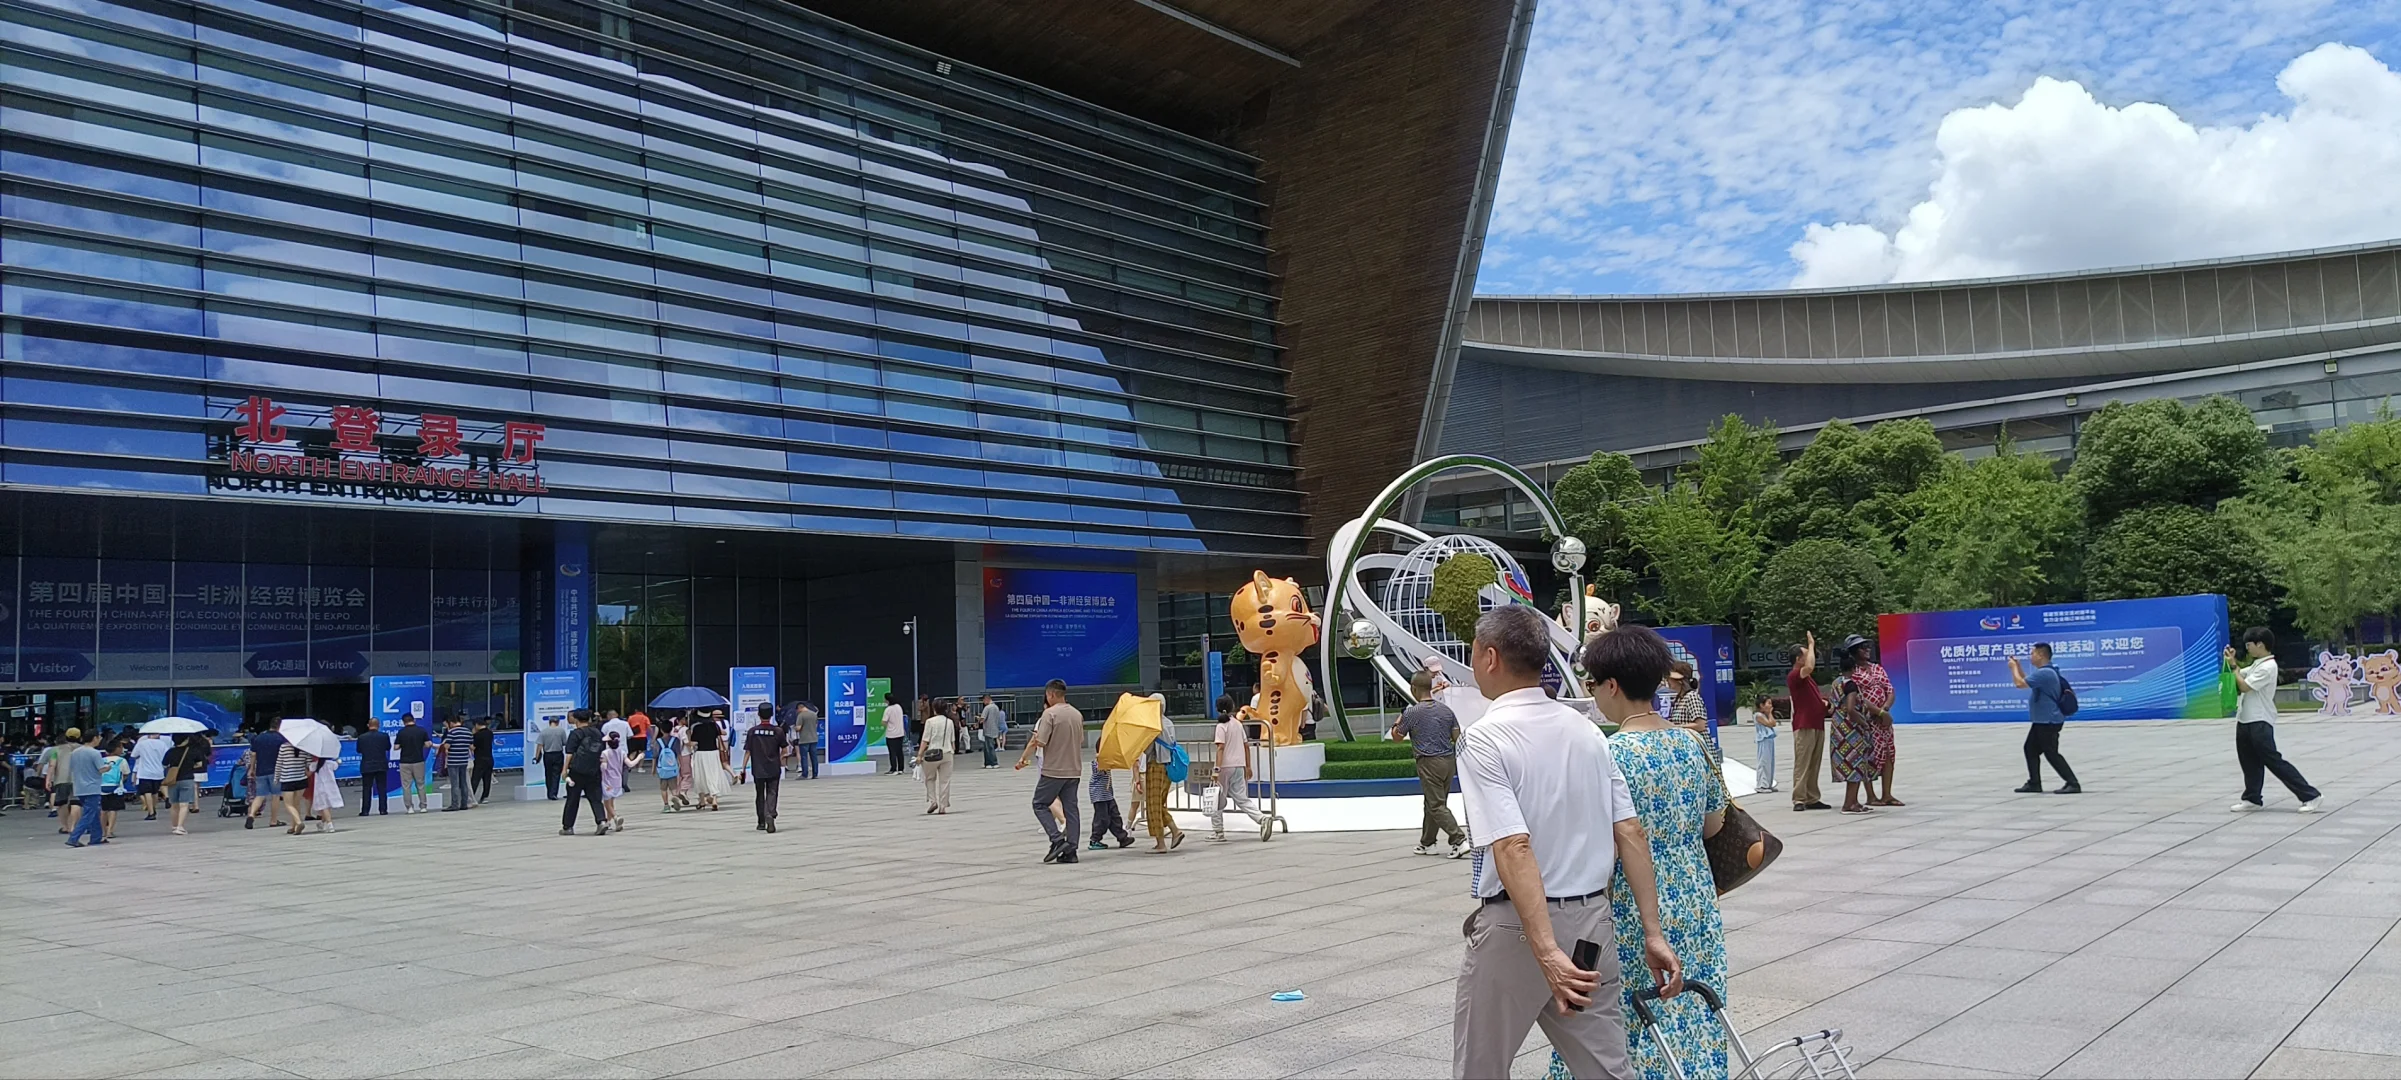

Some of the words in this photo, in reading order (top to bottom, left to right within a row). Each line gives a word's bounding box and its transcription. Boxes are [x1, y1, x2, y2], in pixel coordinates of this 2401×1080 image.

[234, 395, 546, 464] 北登录厅
[230, 450, 331, 477] NORTH
[339, 460, 481, 489] ENTRANCE
[488, 471, 549, 493] HALL
[27, 608, 53, 619] THE
[55, 609, 108, 619] FOURTH
[259, 611, 283, 620] AND
[323, 612, 351, 621] EXPO
[2100, 636, 2145, 651] 欢迎您
[28, 662, 77, 674] Visitor
[318, 660, 355, 670] Visitor
